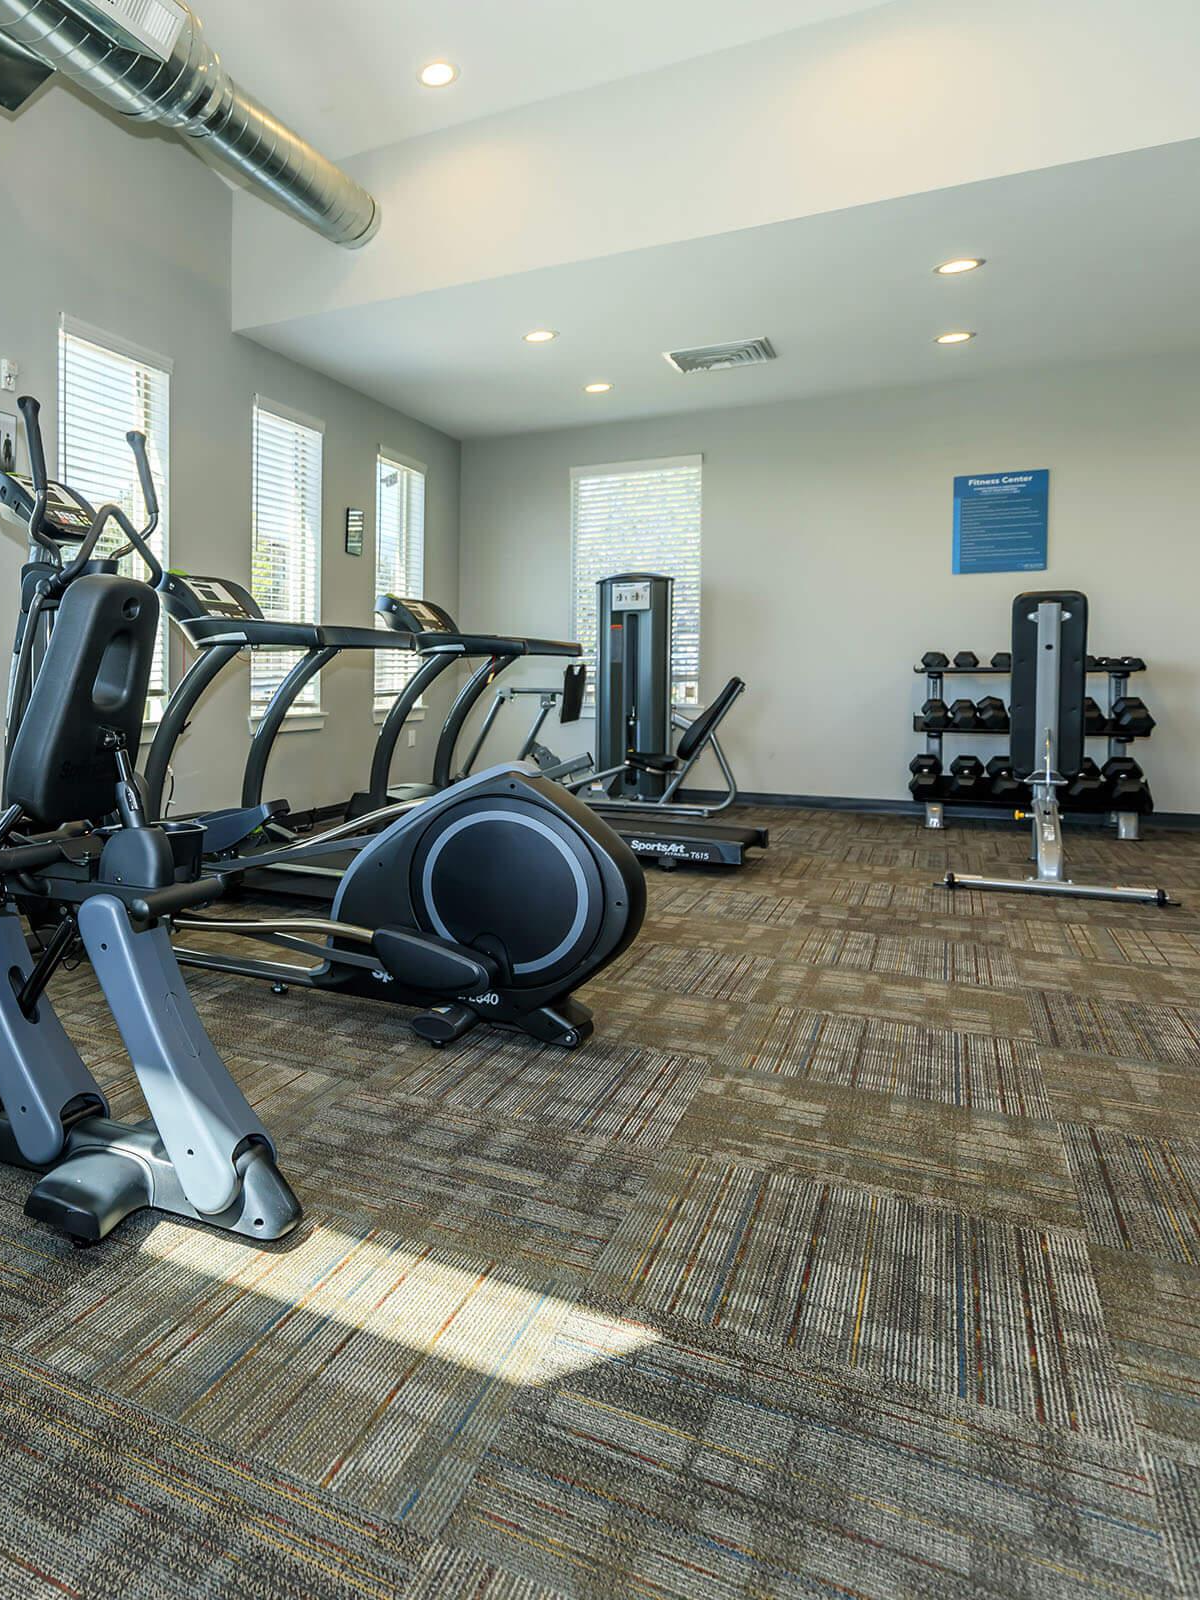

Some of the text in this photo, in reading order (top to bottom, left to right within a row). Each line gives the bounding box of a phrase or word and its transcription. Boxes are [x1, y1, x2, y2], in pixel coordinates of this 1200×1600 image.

[968, 476, 1033, 486] Fitness Center
[631, 839, 686, 853] SportsArt
[690, 851, 710, 860] T615
